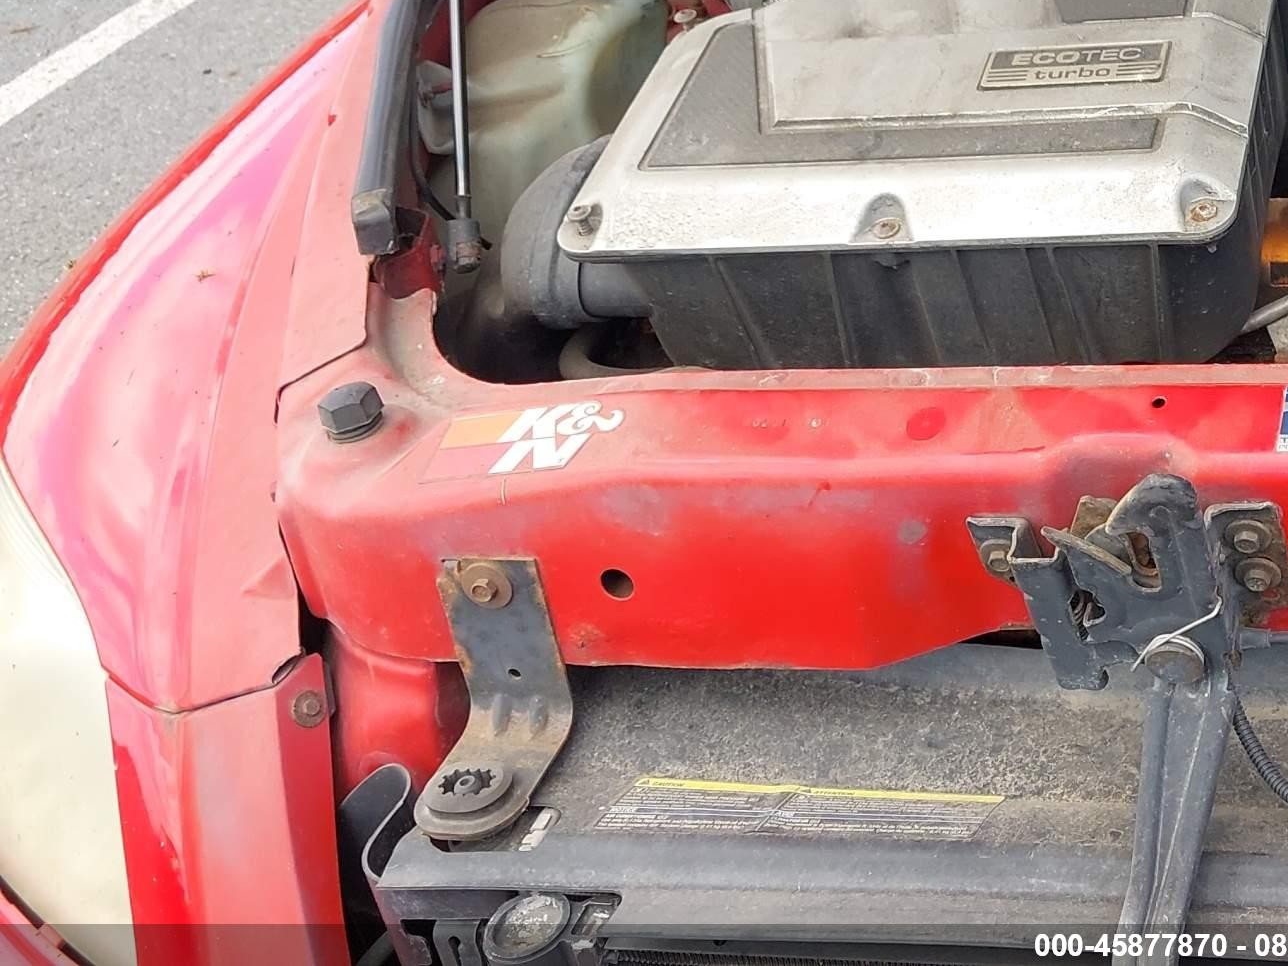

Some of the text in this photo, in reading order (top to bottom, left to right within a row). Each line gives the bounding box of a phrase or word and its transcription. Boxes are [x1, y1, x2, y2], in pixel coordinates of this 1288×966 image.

[1011, 47, 1142, 67] ECOTEC
[1034, 67, 1111, 81] turbo
[487, 400, 625, 474] K&N
